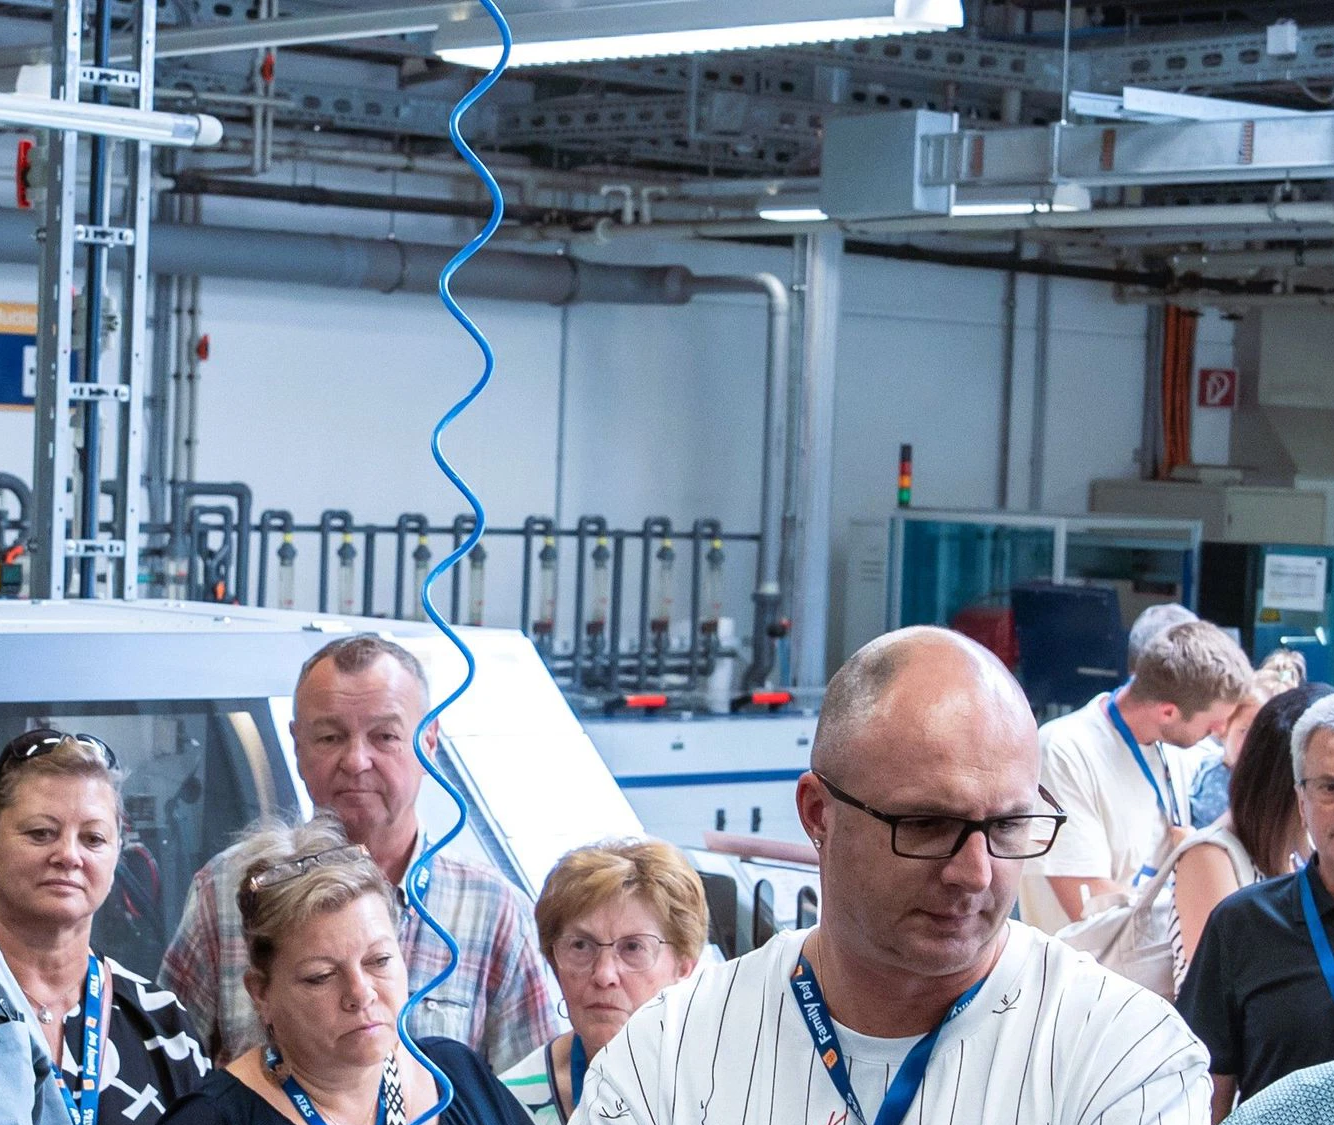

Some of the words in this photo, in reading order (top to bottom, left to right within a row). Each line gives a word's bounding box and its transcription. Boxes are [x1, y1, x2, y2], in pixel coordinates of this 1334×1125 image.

[796, 980, 814, 1000] Day
[803, 1003, 832, 1045] Family
[293, 1094, 315, 1118] AT&S
